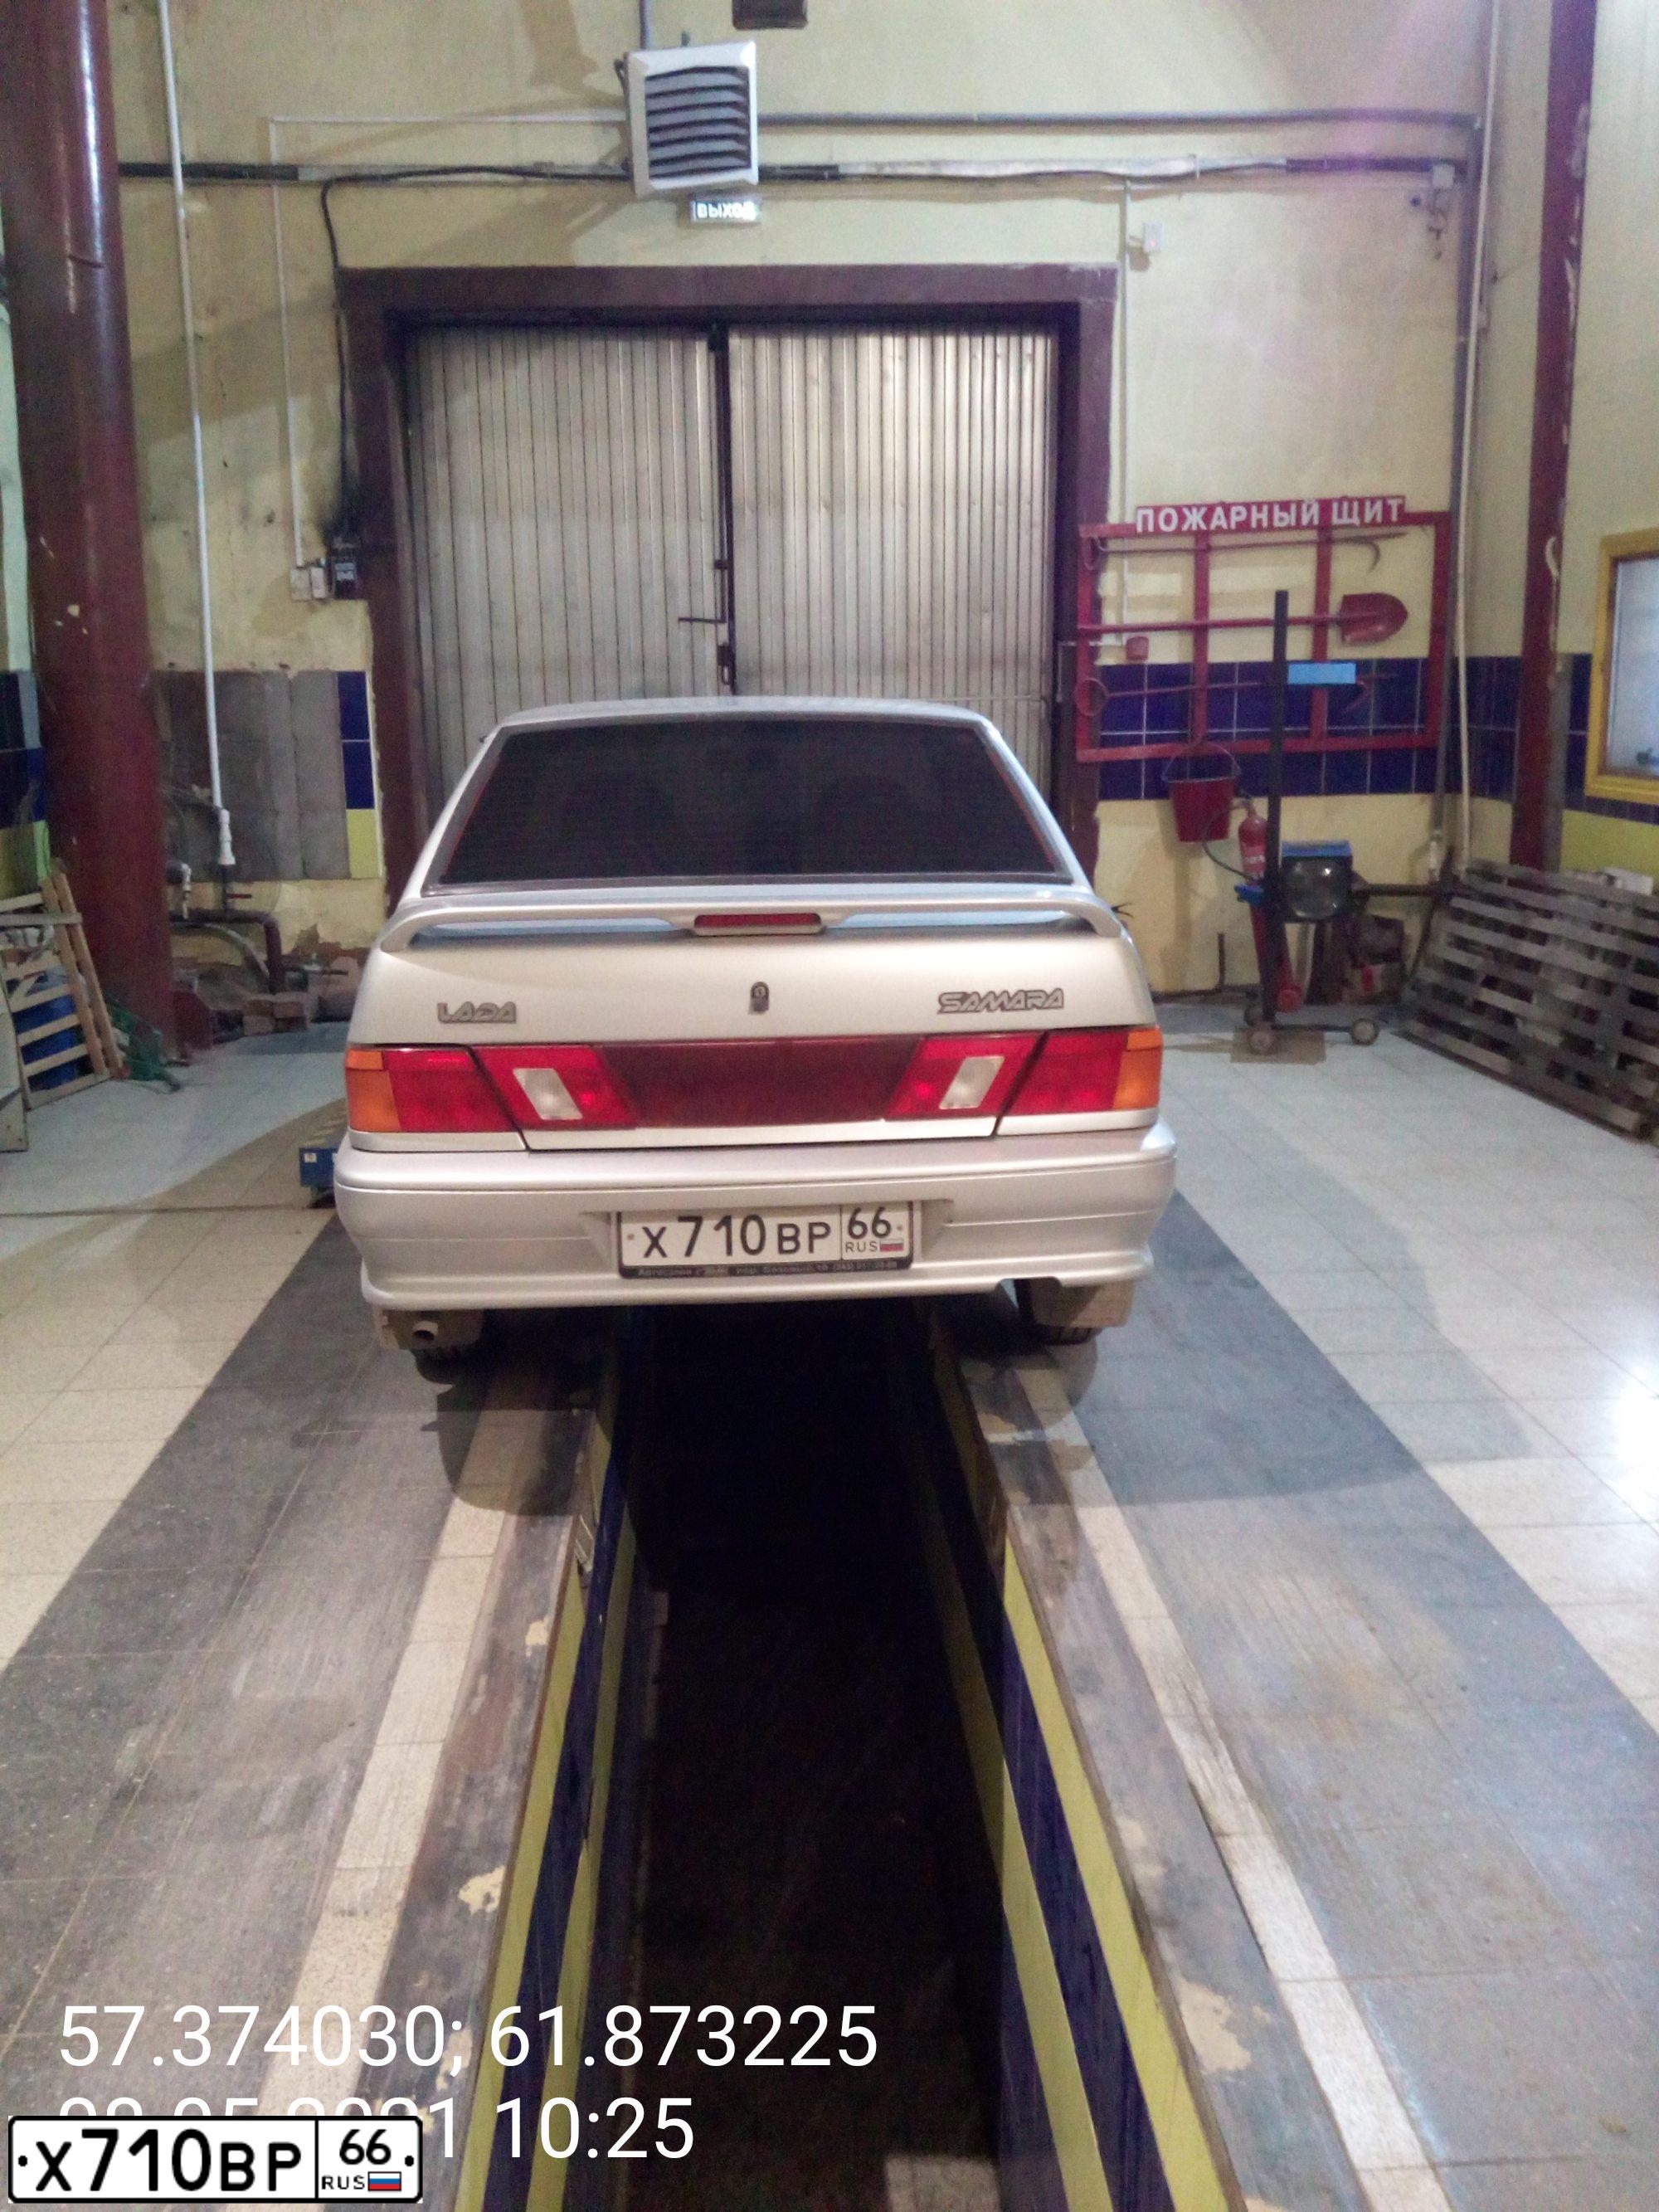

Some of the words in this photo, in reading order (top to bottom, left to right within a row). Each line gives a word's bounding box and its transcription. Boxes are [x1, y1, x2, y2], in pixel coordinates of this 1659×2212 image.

[1136, 499, 1320, 534] ПОЖАРНЫЙ
[1331, 498, 1403, 526] ЩИТ
[436, 1001, 517, 1024] LADA
[937, 987, 1064, 1014] SAMARA
[641, 1214, 831, 1259] Х710ВР
[847, 1207, 892, 1240] 66
[844, 1240, 879, 1254] RUS
